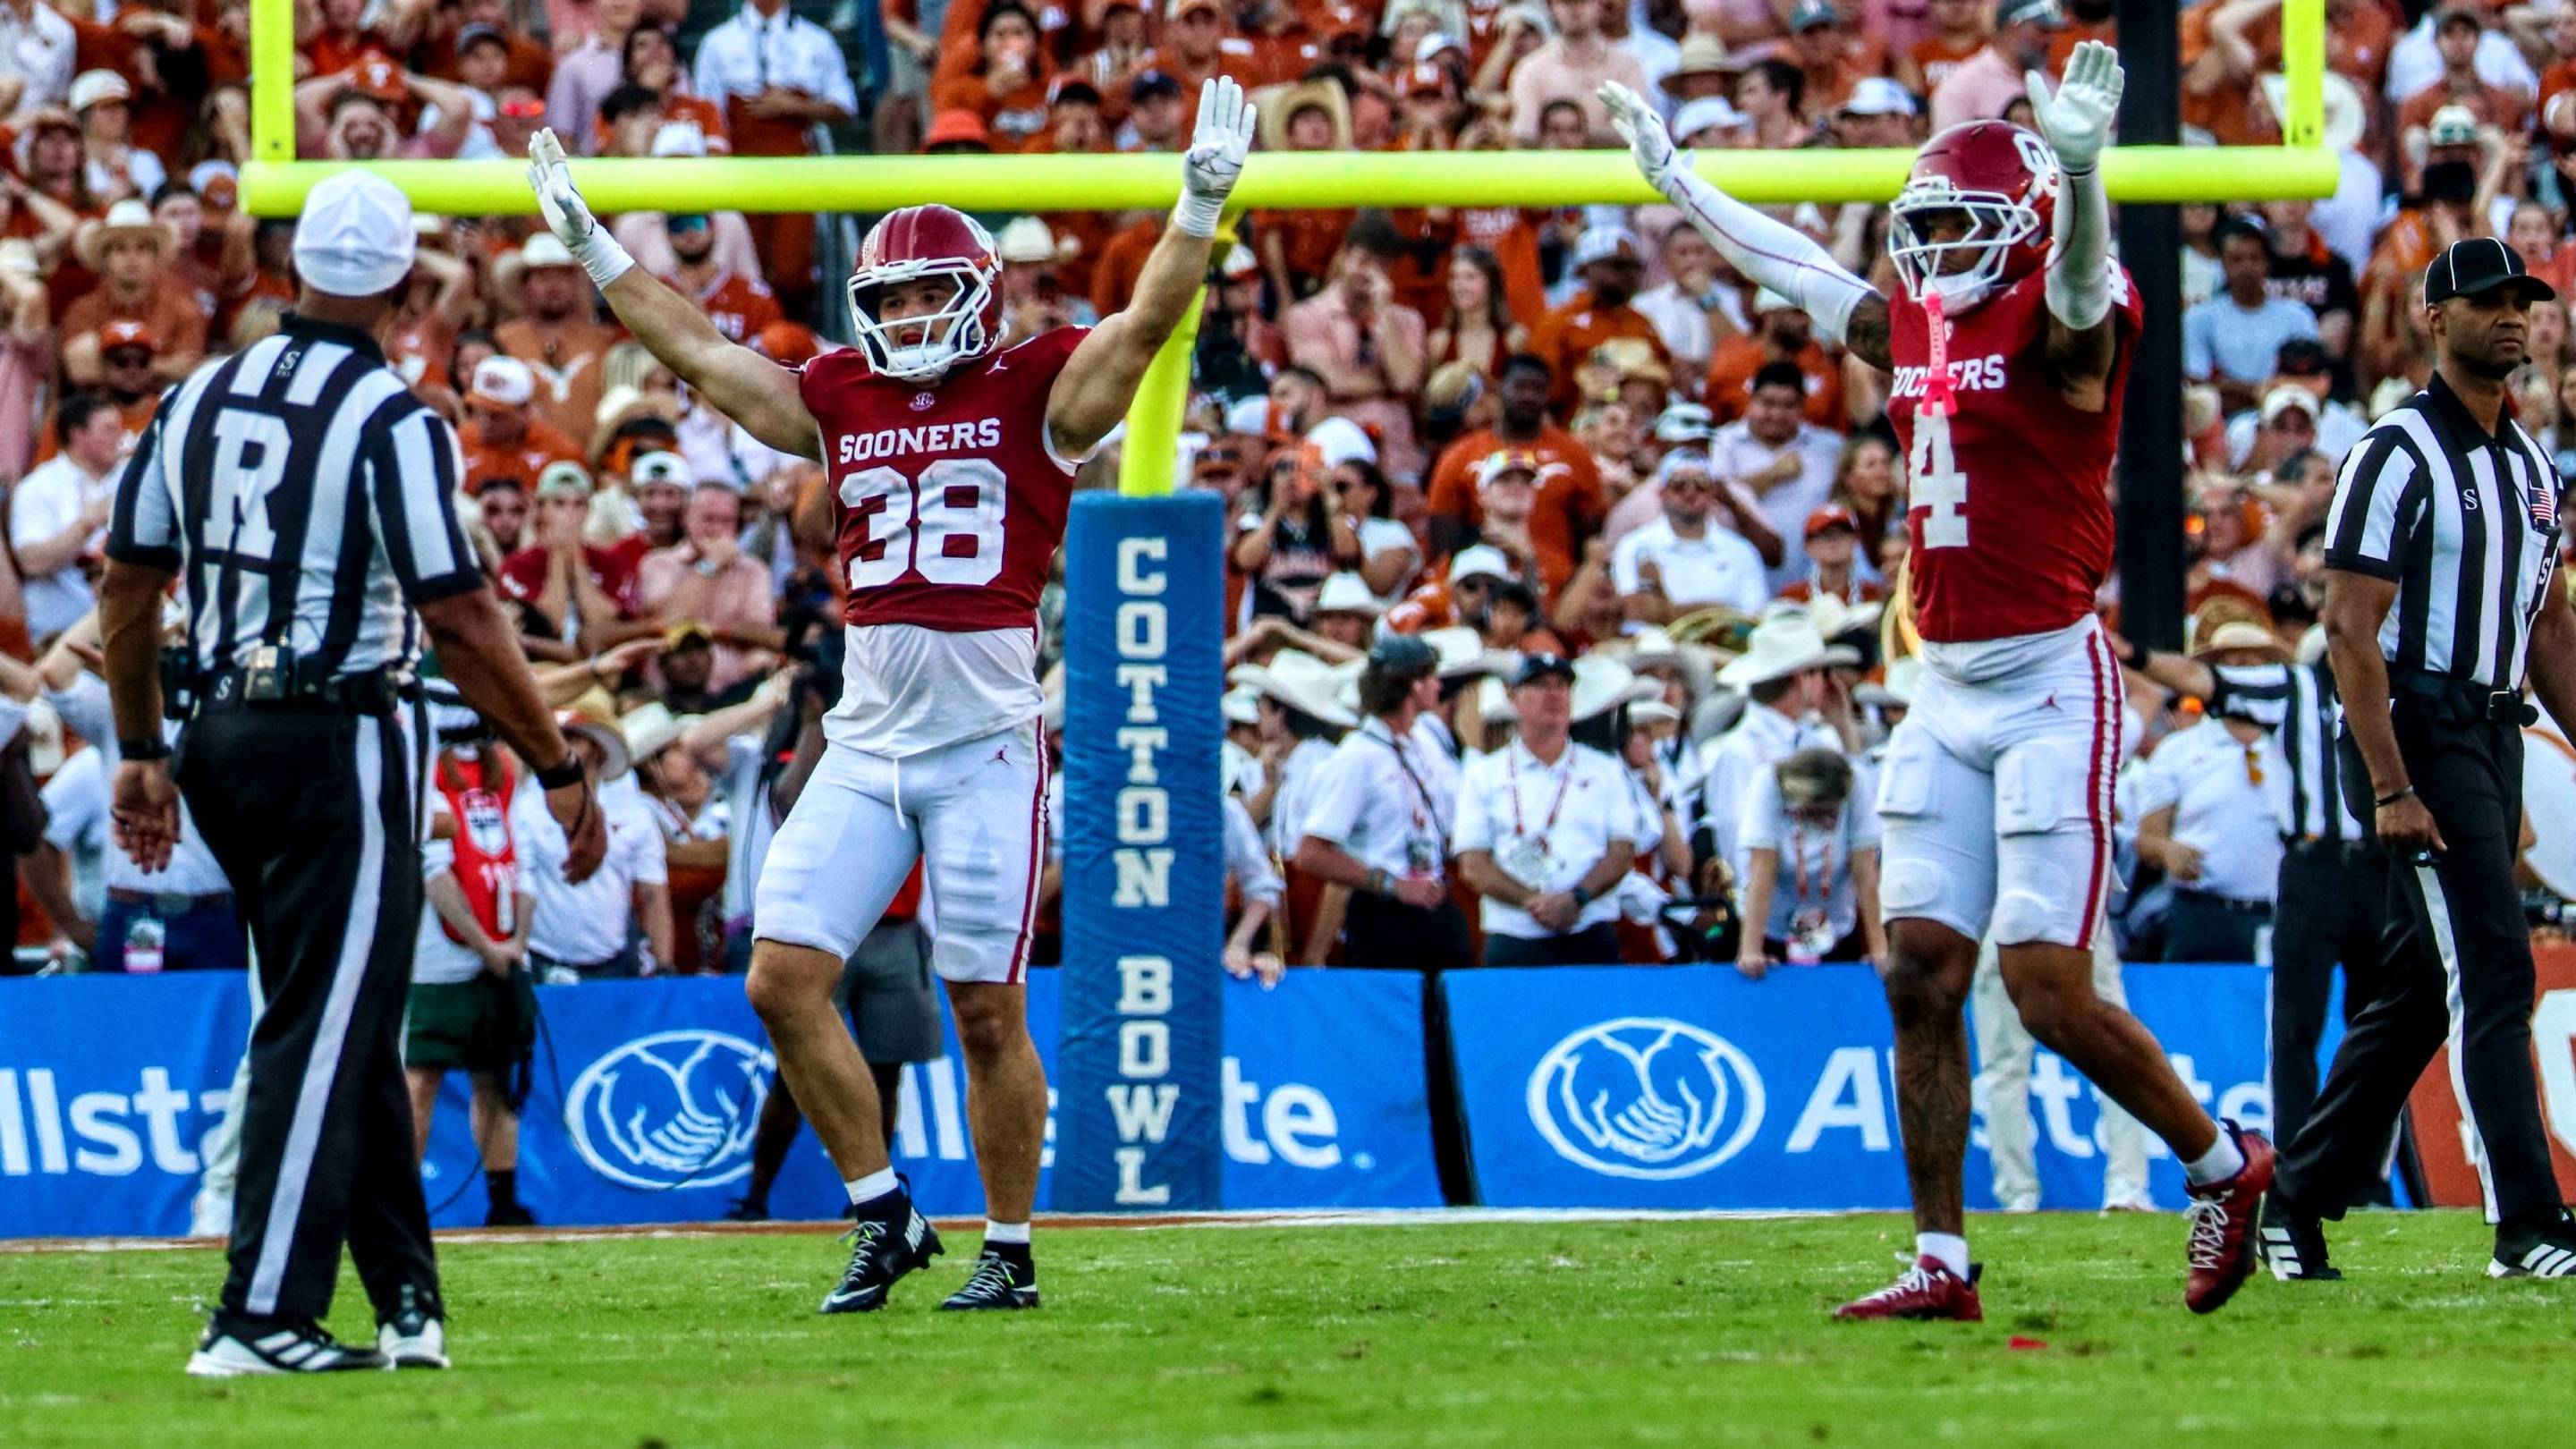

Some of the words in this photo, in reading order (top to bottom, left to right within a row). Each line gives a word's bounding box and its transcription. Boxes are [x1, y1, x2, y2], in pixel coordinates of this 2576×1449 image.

[203, 407, 292, 561] R
[839, 417, 1002, 465] SOONERS
[1908, 401, 1970, 549] 4
[838, 457, 1007, 590] 38
[1112, 537, 1176, 909] COTTON
[1105, 954, 1180, 1205] BOWL
